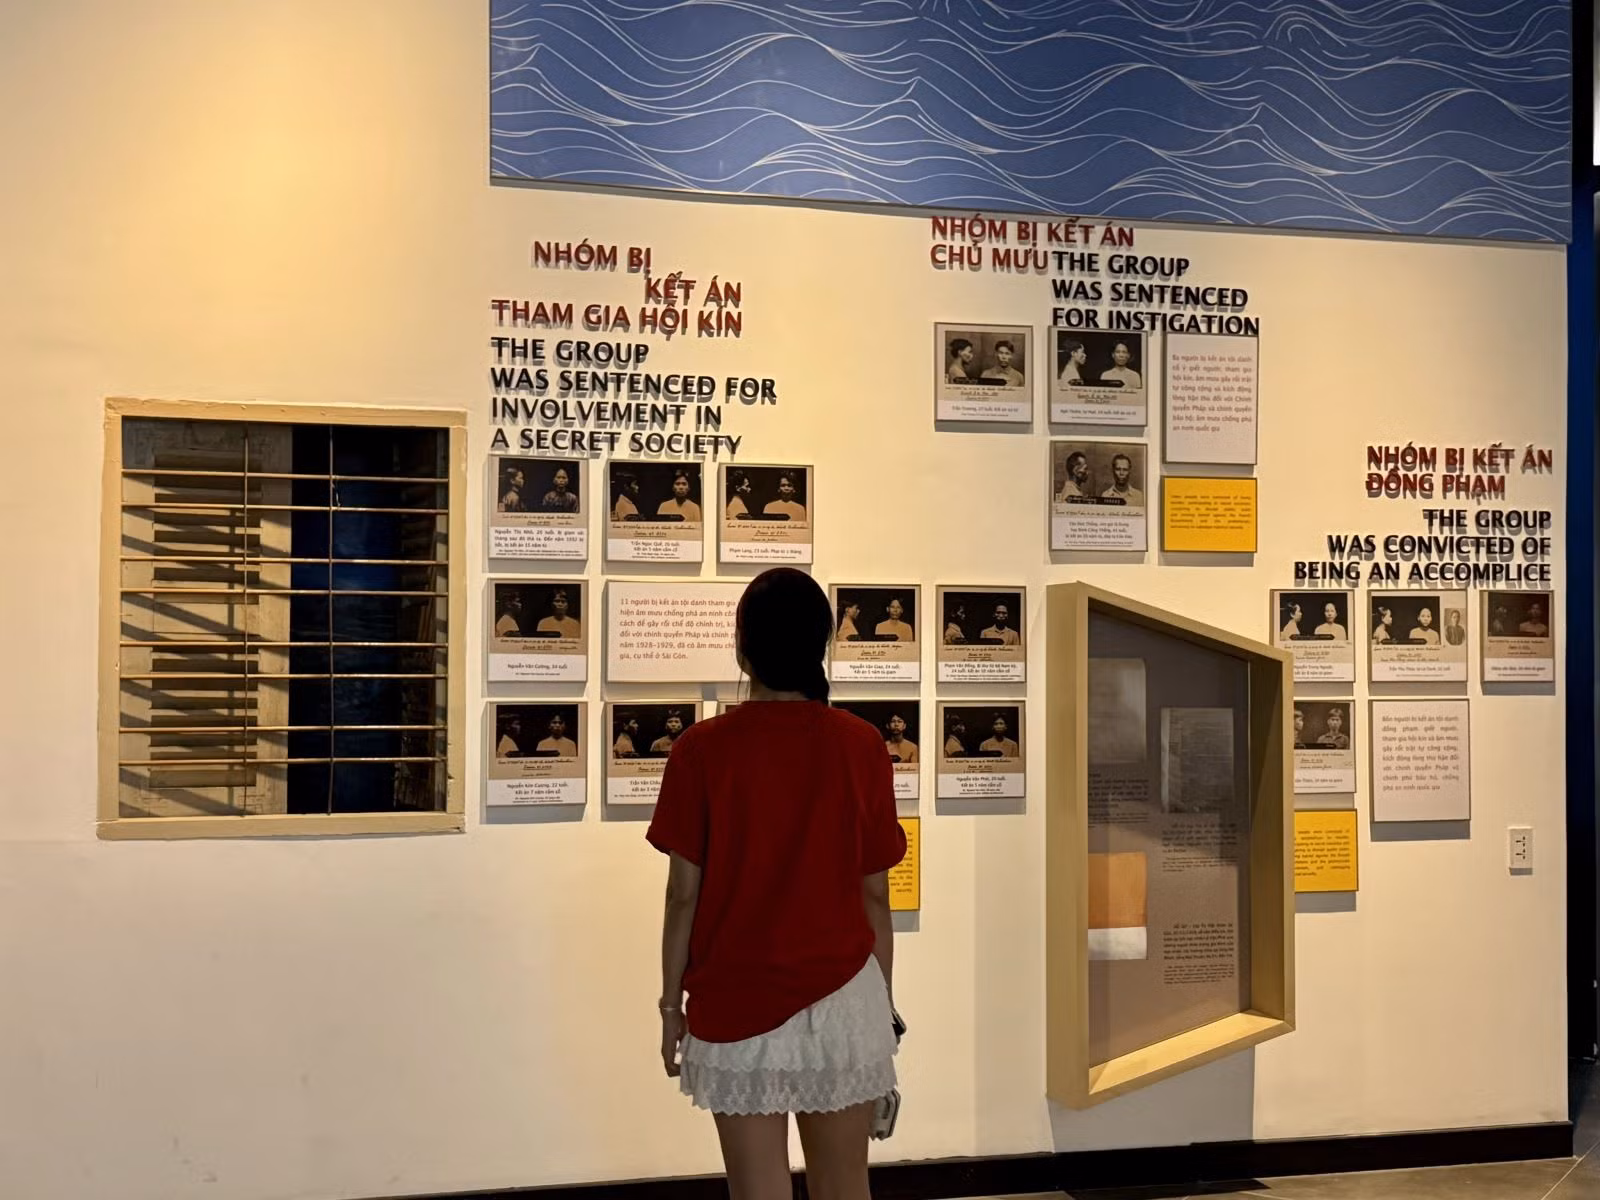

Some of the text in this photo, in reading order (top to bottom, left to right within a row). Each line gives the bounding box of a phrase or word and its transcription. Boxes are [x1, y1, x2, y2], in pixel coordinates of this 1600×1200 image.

[931, 213, 1134, 247] NHÓM BỊ KẾT ÁN
[534, 239, 651, 274] NHÓM BỊ
[931, 239, 1048, 269] CHỦ MƯU
[1052, 251, 1189, 276] THE GROUP
[647, 271, 741, 302] KẾT ÁN
[1052, 280, 1247, 307] WAS SENTENCED
[491, 300, 741, 334] THAM GIA HỘI KÍN
[1053, 308, 1259, 335] FOR INSTIGATION
[491, 337, 648, 363] THE GROUP
[490, 368, 776, 398] WAS SENTENCED FOR
[492, 397, 721, 425] INVOLVEMENT IN
[491, 428, 741, 454] A SECRET SOCIETY
[1367, 442, 1552, 472] NHÓM BỊ KẾT ÁN
[1423, 509, 1550, 528] THE GROUP
[1327, 535, 1550, 555] WAS CONVICTED OF
[1295, 562, 1550, 581] BEING AN ACCOMPLICE
